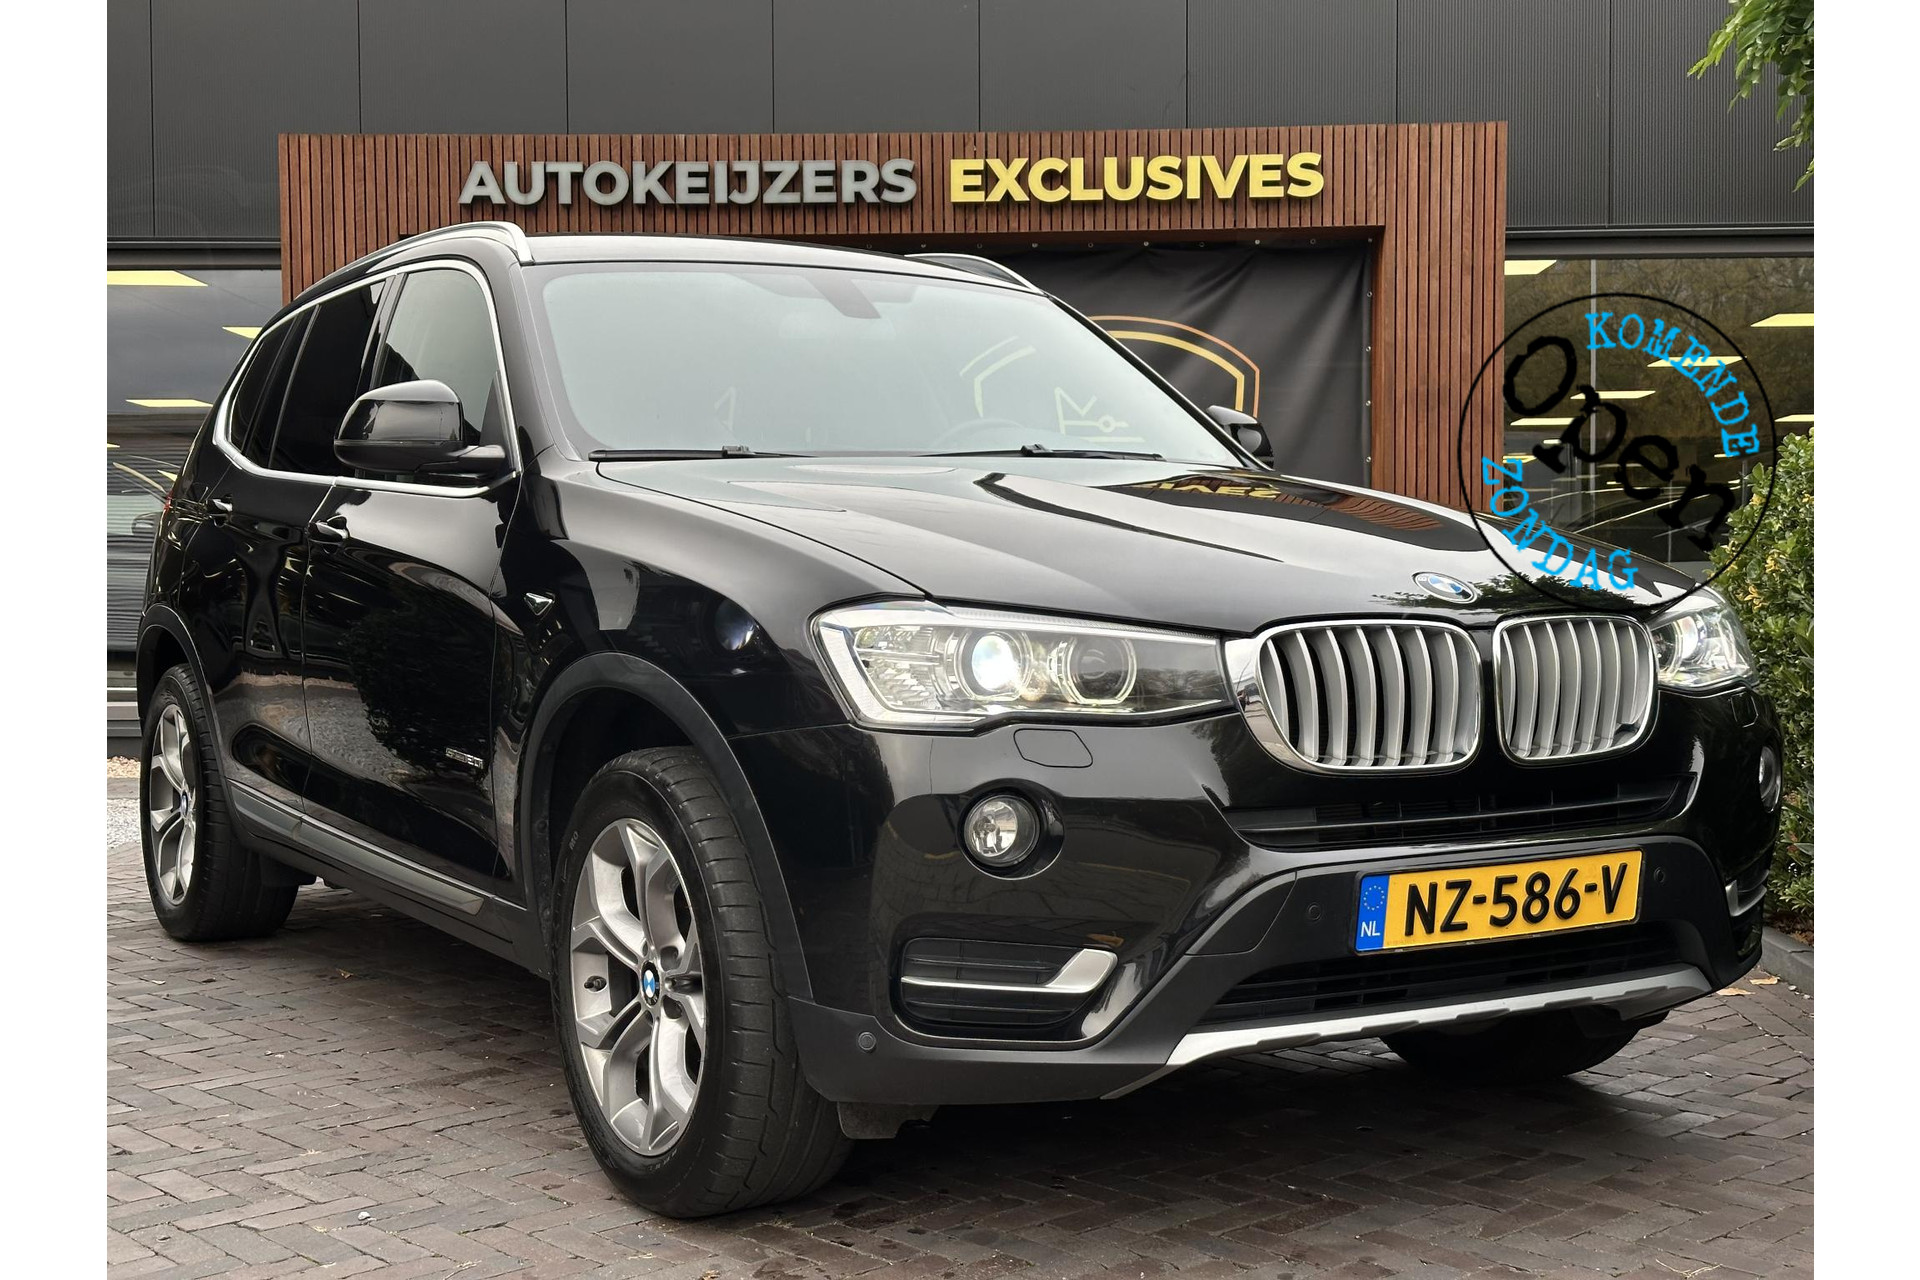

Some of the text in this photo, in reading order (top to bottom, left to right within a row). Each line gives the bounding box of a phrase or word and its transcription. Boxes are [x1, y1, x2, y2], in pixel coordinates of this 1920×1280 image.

[459, 152, 1325, 206] AUTOKEIJZERS EXCLUSIVES
[1405, 863, 1628, 936] NZ-586-V
[1360, 920, 1381, 937] NL
